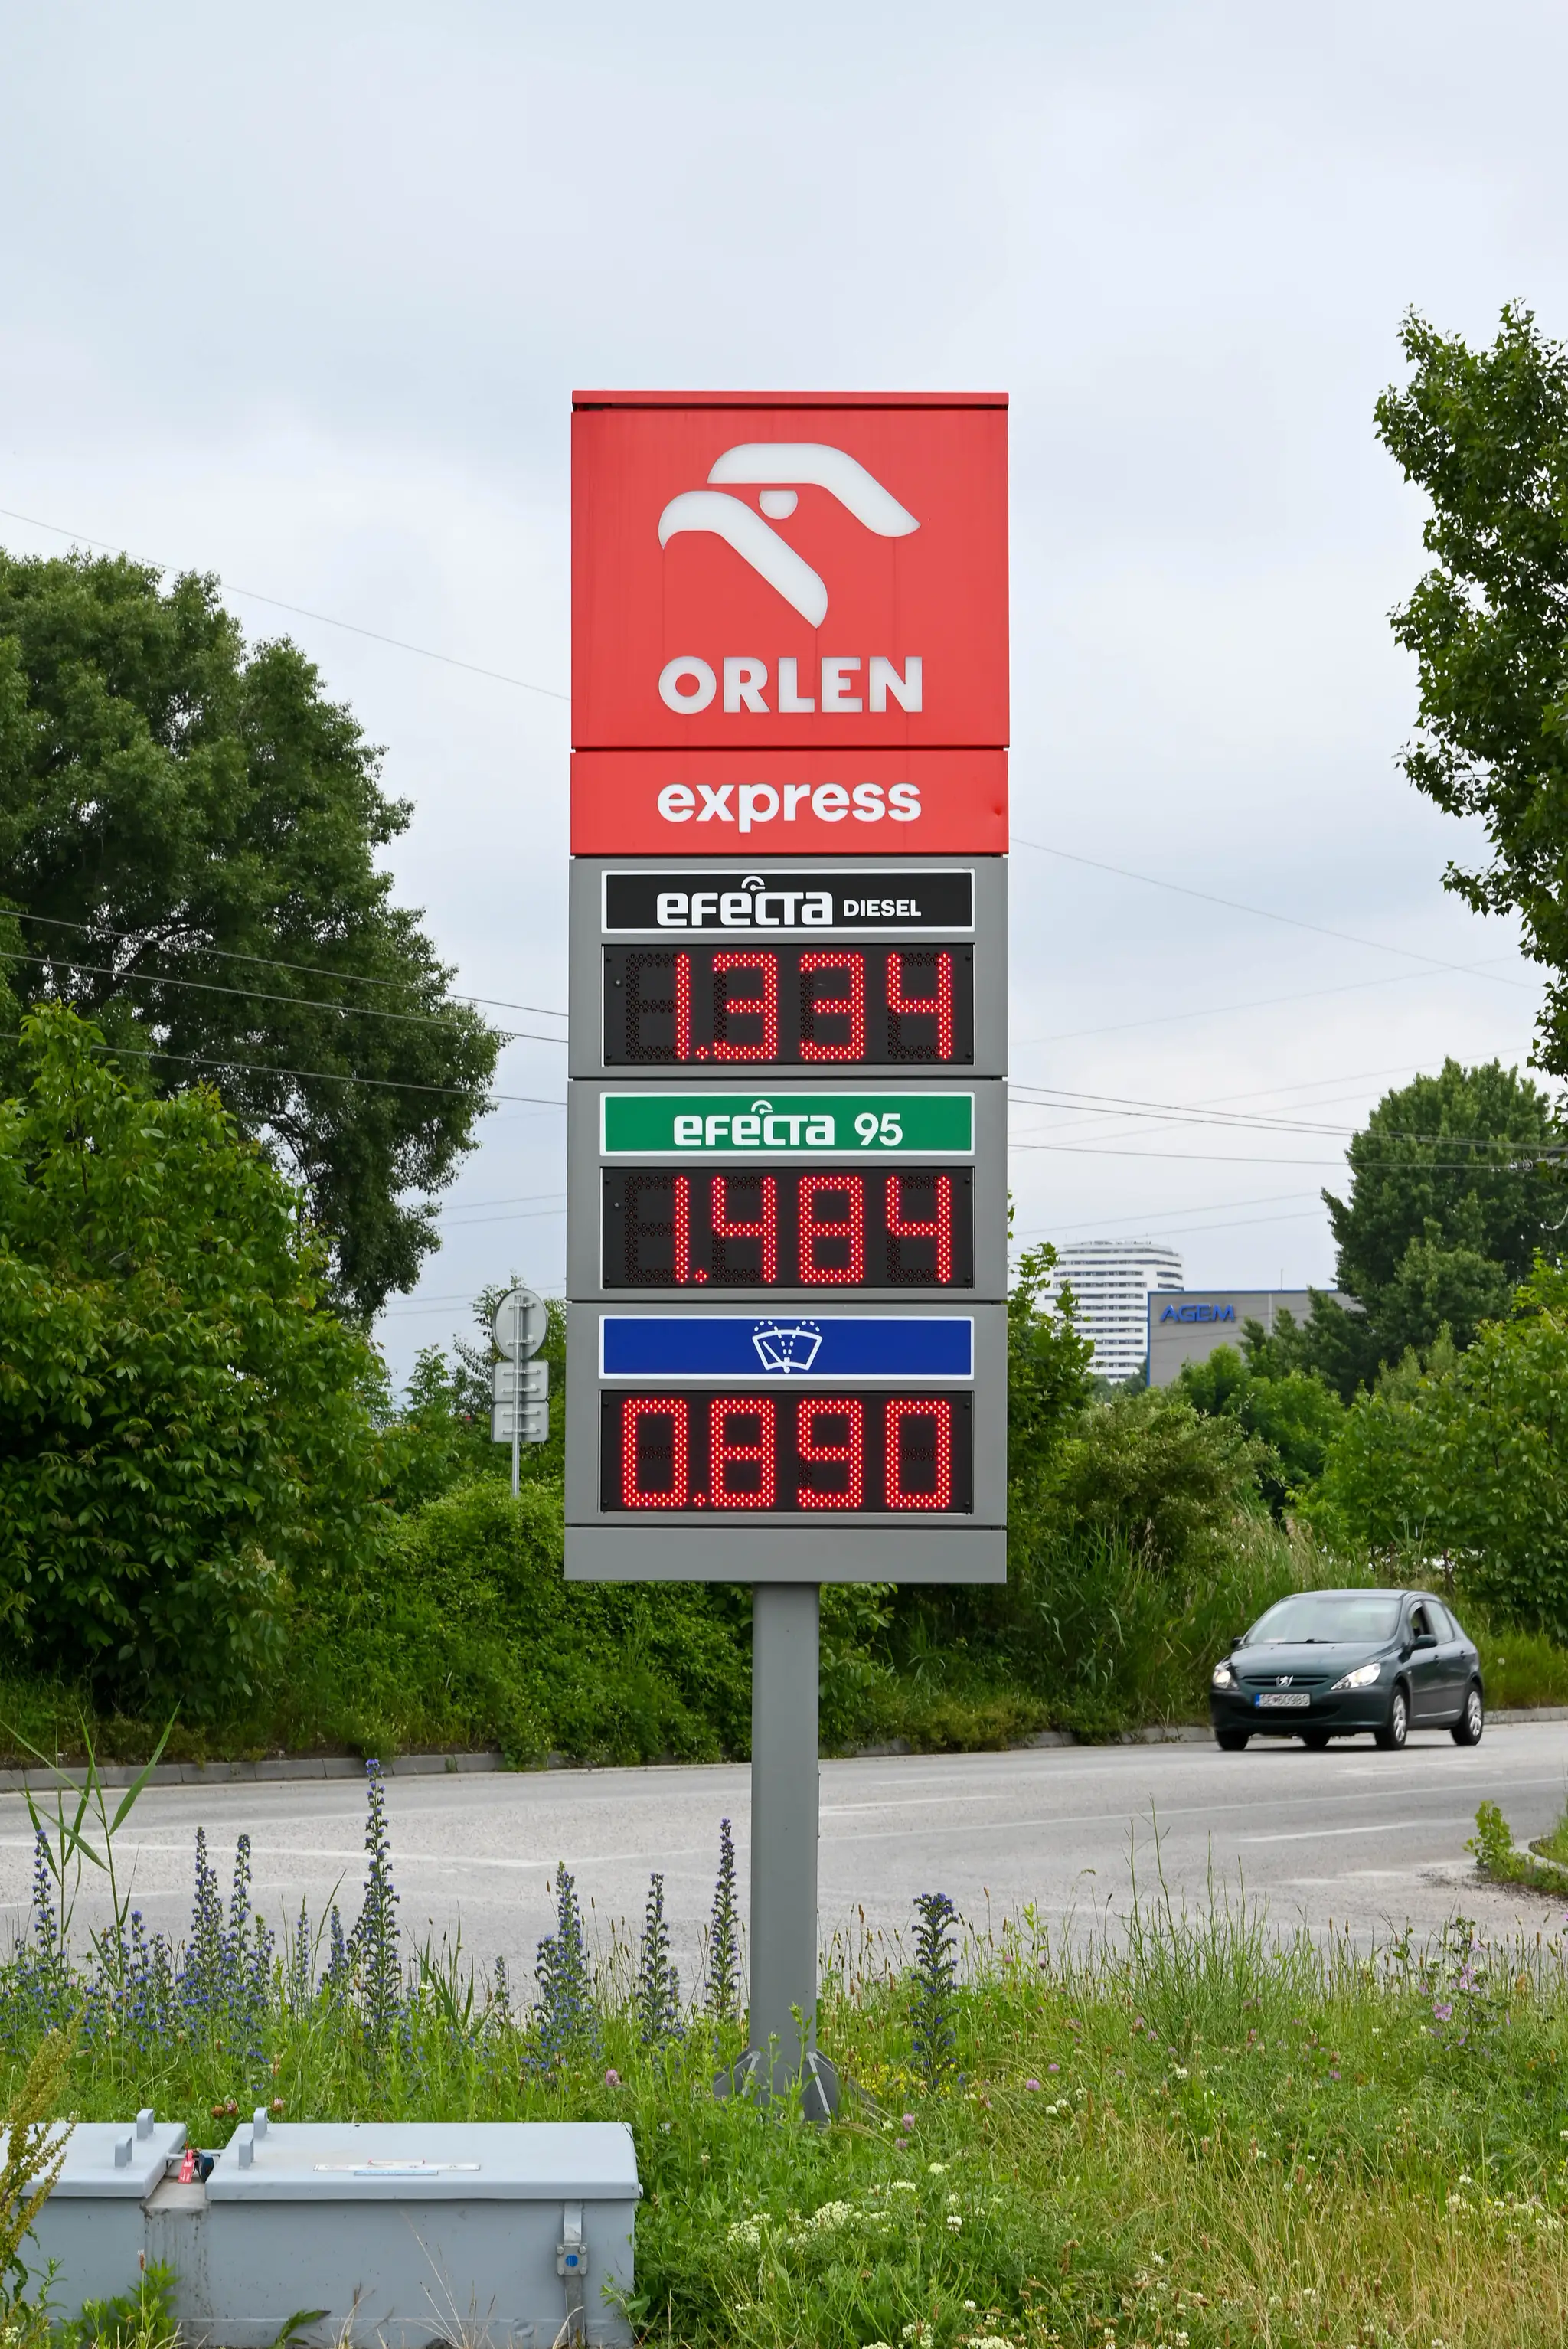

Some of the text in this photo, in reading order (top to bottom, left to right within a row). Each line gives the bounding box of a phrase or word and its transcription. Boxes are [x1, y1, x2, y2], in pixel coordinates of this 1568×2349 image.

[658, 655, 923, 714] ORLEN
[657, 782, 922, 833] express
[843, 899, 922, 917] DIESEL
[676, 952, 952, 1060] 1.334
[854, 1112, 903, 1147] 95
[675, 1176, 952, 1283] 1.484
[1159, 1304, 1235, 1322] AGEM
[622, 1399, 952, 1508] 0.890
